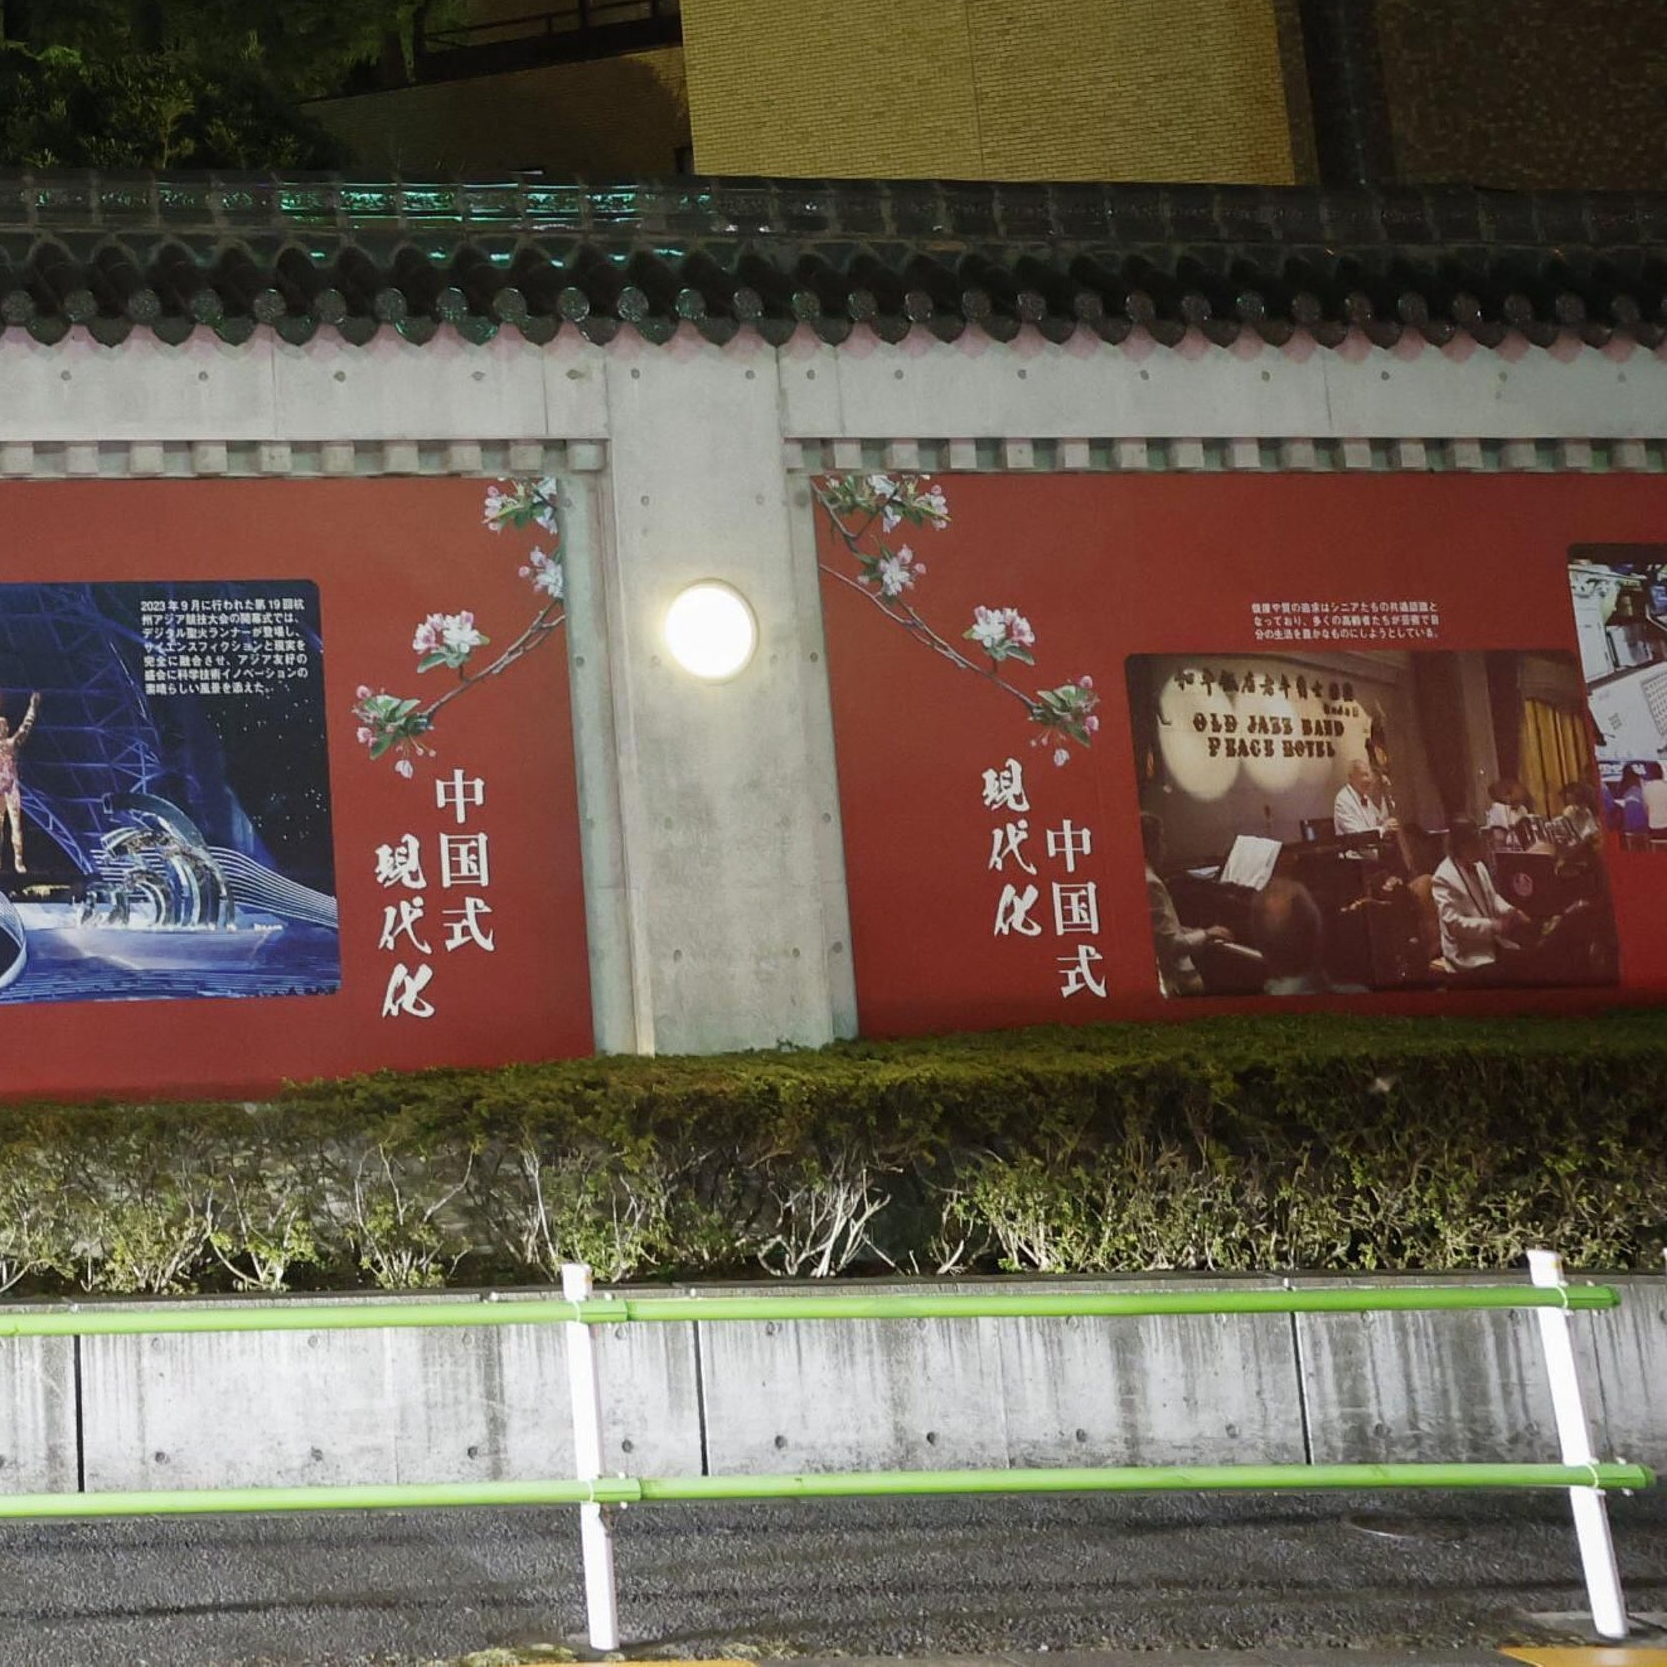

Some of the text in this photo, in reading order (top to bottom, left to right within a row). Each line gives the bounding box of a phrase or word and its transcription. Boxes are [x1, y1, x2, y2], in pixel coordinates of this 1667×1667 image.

[141, 613, 300, 625] 州アジア競技大会の開幕式では、
[142, 626, 301, 639] デジタル聖火ランナーが登場し、
[144, 640, 306, 653] サイエンスフィクションと現実を
[143, 654, 308, 667] 完全に融合させ、アジア友好の
[145, 682, 269, 695] 素晴らしい風景を添えた。
[1193, 712, 1345, 736] OLD JAZZ BAND
[1208, 736, 1336, 758] PEACE HOTEL
[981, 757, 1042, 937] 現代化
[435, 768, 495, 952] 中国式
[1046, 819, 1107, 999] 中国式
[374, 833, 436, 1019] 現代化
